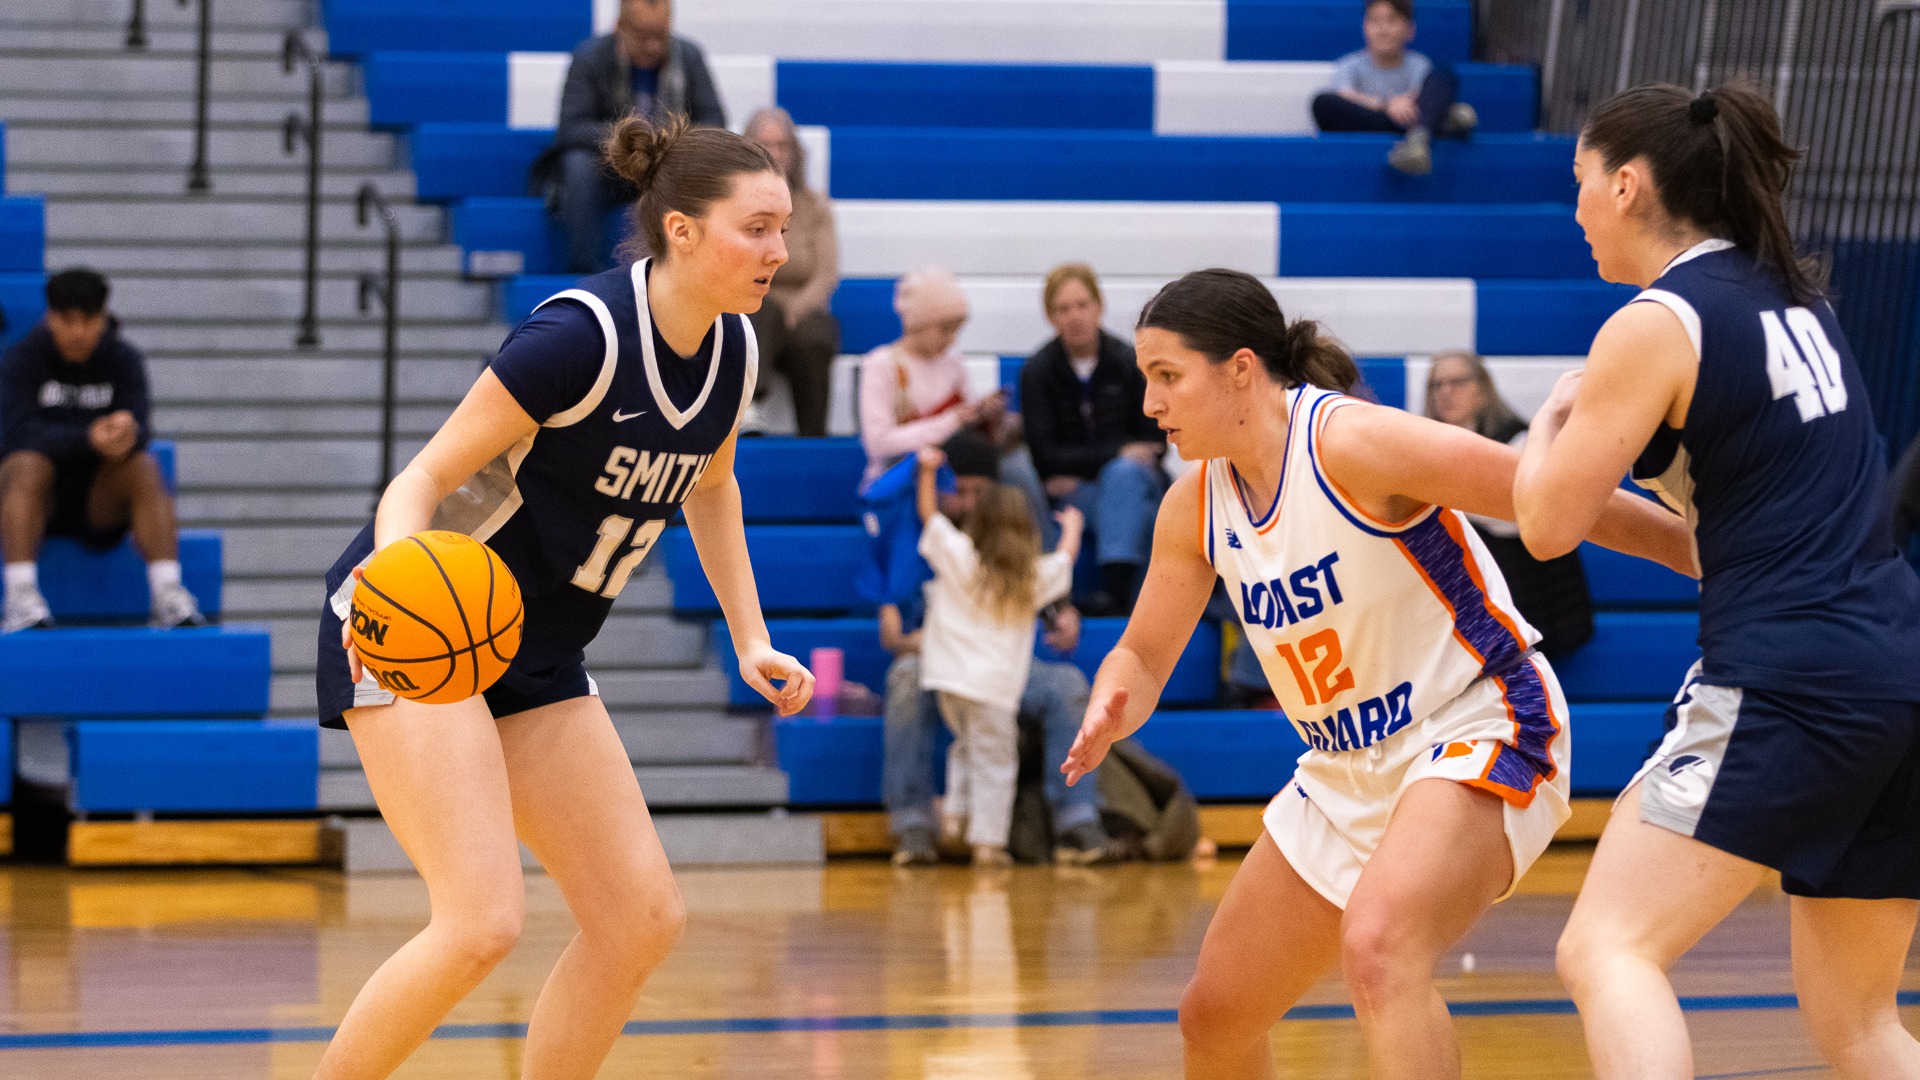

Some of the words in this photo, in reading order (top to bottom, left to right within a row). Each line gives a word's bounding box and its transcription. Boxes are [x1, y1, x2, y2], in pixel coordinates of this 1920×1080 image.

[1759, 306, 1849, 423] 40
[594, 445, 713, 504] SMITH
[569, 513, 667, 600] 12
[1275, 628, 1356, 706] 12
